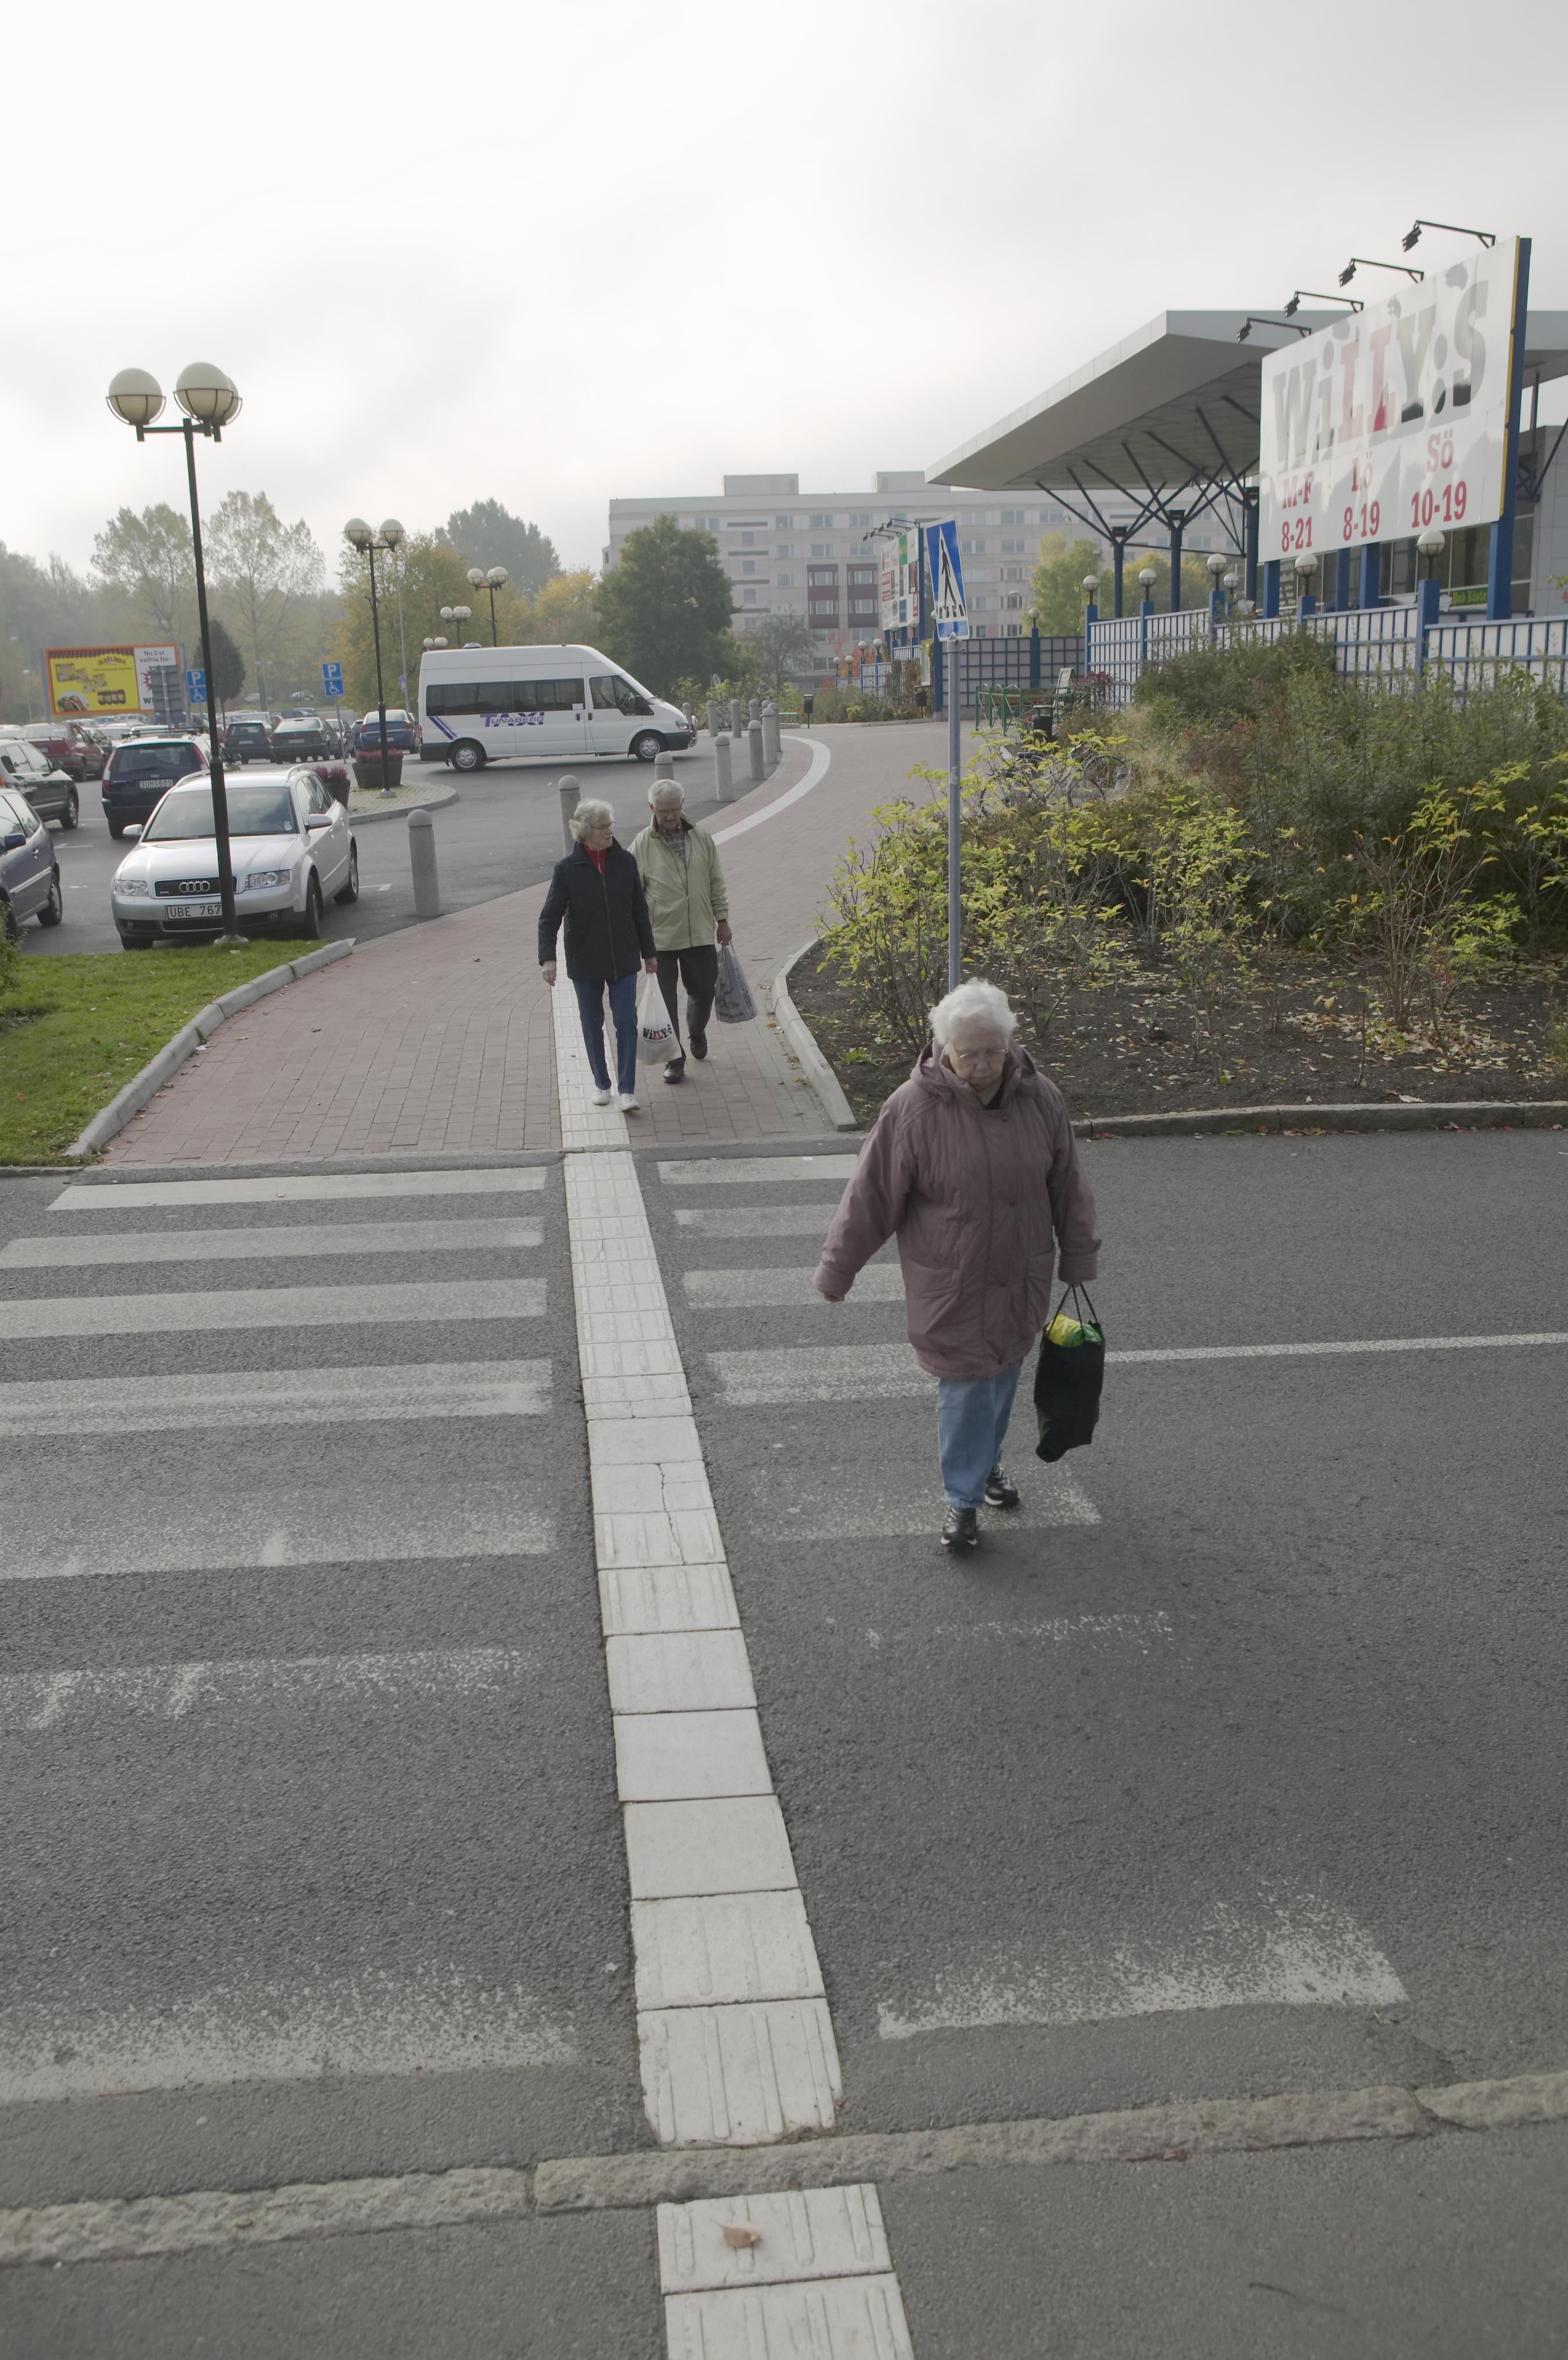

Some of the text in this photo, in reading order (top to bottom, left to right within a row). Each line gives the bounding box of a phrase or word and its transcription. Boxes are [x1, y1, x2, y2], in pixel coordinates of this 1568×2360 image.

[1282, 429, 1454, 509] M-F Lö Sö
[1282, 481, 1468, 552] 8-21 8-19 10-19
[328, 664, 337, 677] P
[191, 671, 201, 685] P
[170, 905, 221, 918] UBE 767
